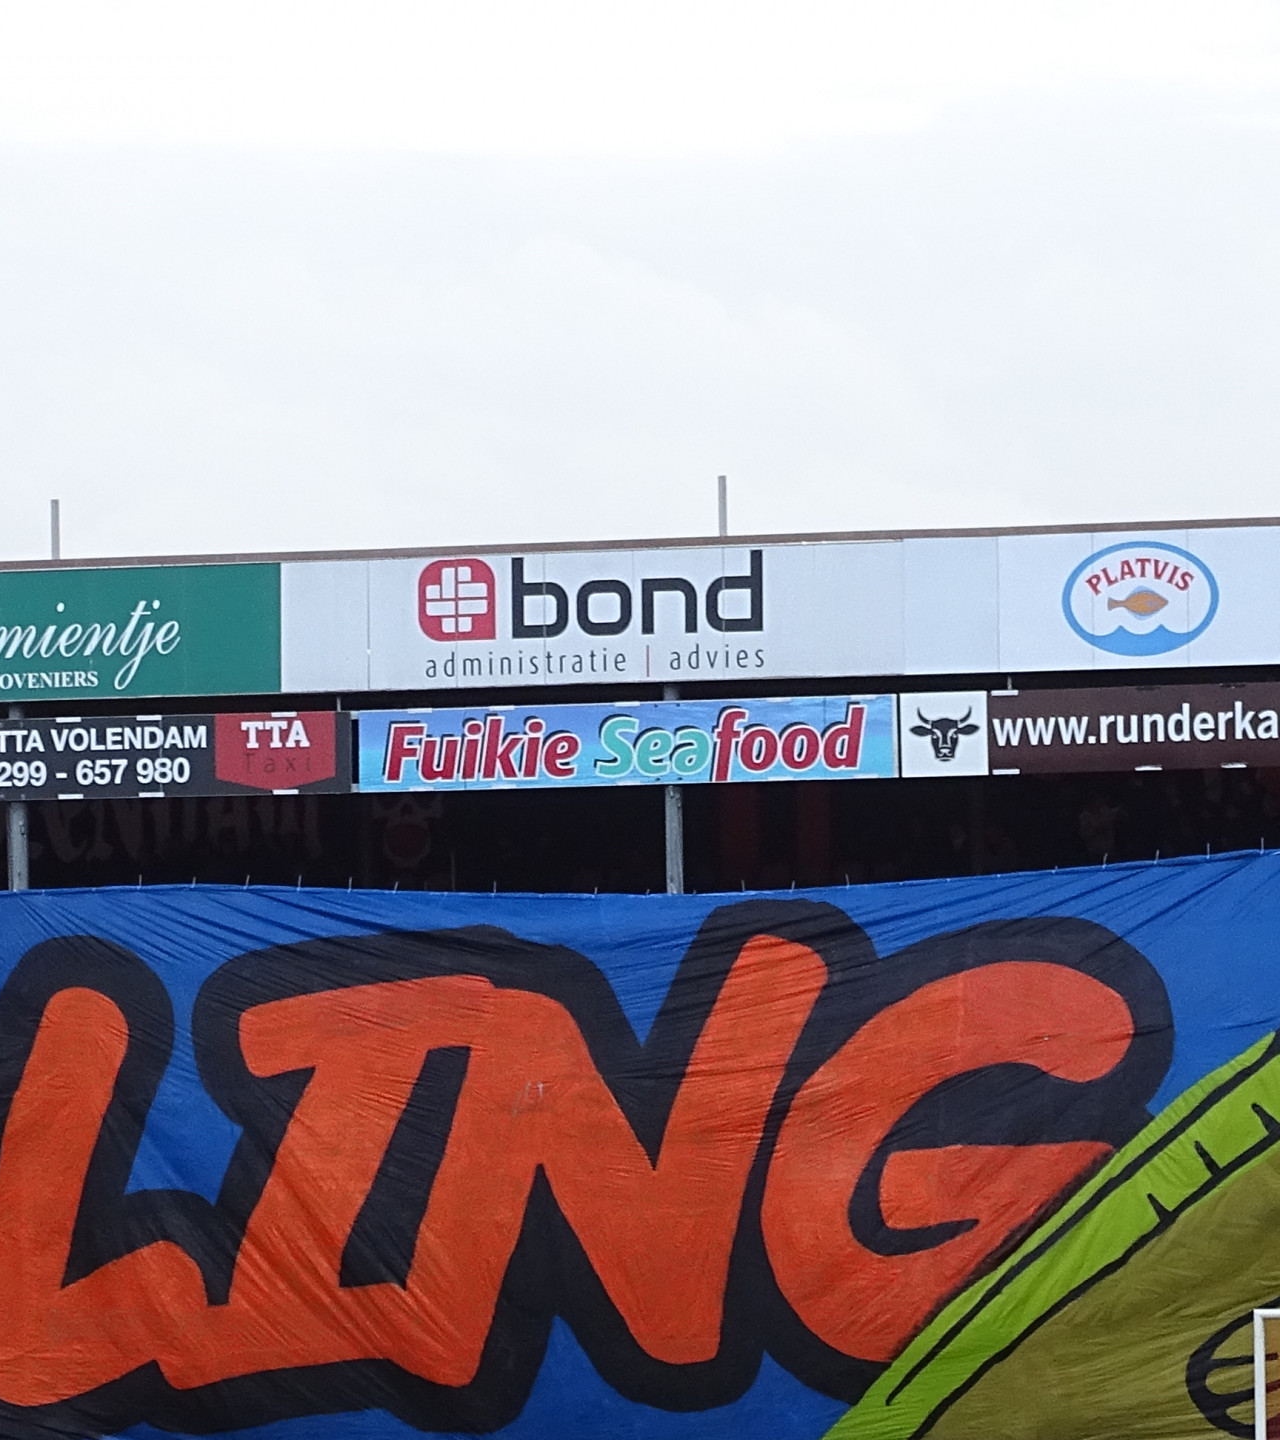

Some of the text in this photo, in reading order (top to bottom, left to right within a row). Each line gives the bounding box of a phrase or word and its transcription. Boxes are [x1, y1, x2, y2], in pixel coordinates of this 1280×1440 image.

[1084, 556, 1196, 597] PLATVIS
[511, 549, 764, 640] bond
[424, 644, 766, 679] administratie advies
[50, 725, 208, 752] VOLENDAM
[240, 719, 311, 750] TTA
[384, 700, 867, 783] Fuikie Seafood
[74, 759, 125, 786] 657
[136, 757, 191, 784] 980
[242, 750, 313, 775] Taxi
